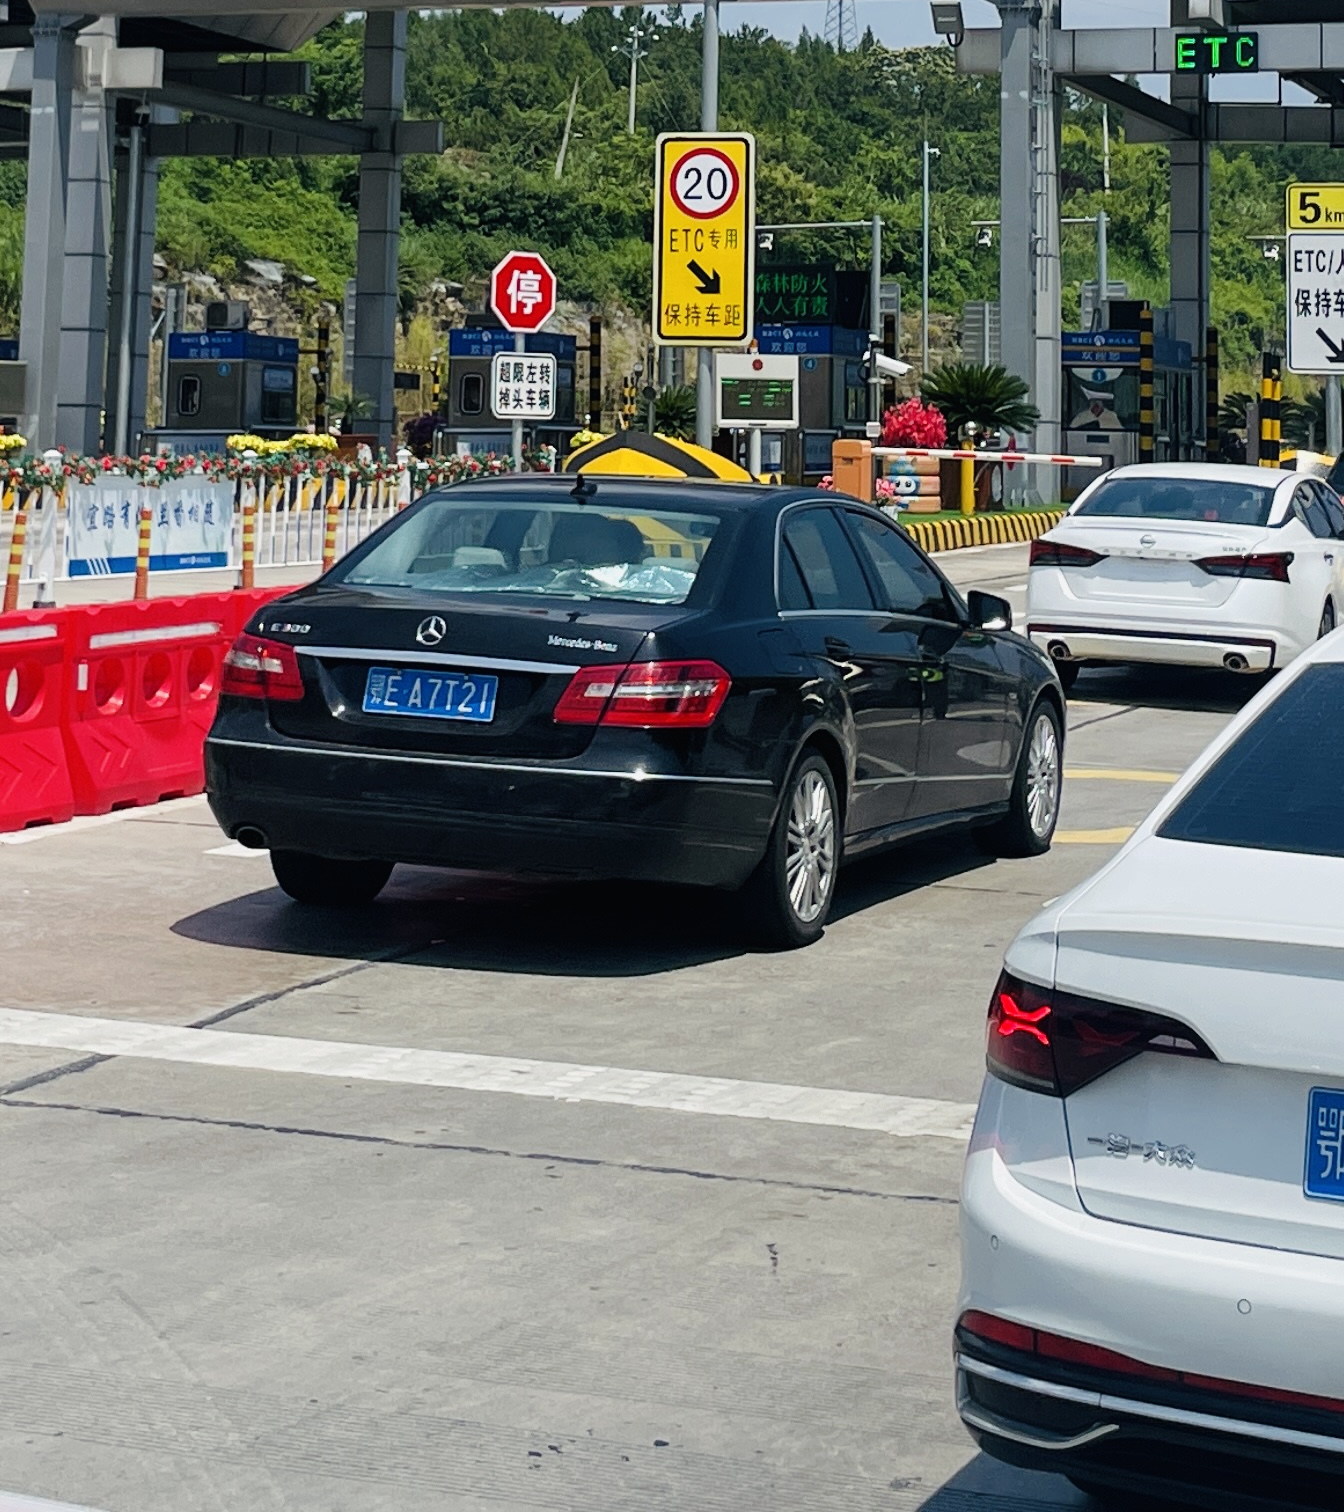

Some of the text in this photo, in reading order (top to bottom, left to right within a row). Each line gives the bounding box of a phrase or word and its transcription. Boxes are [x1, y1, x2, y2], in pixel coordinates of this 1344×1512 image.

[1177, 37, 1254, 69] ETC
[683, 167, 728, 201] 20
[1299, 192, 1321, 224] 5
[670, 228, 738, 252] ETC 专用
[507, 270, 542, 315] 停
[756, 273, 828, 294] 森林防火
[664, 303, 741, 327] 保持车距
[756, 296, 828, 317] 人人有责
[499, 362, 550, 386] 超限左转
